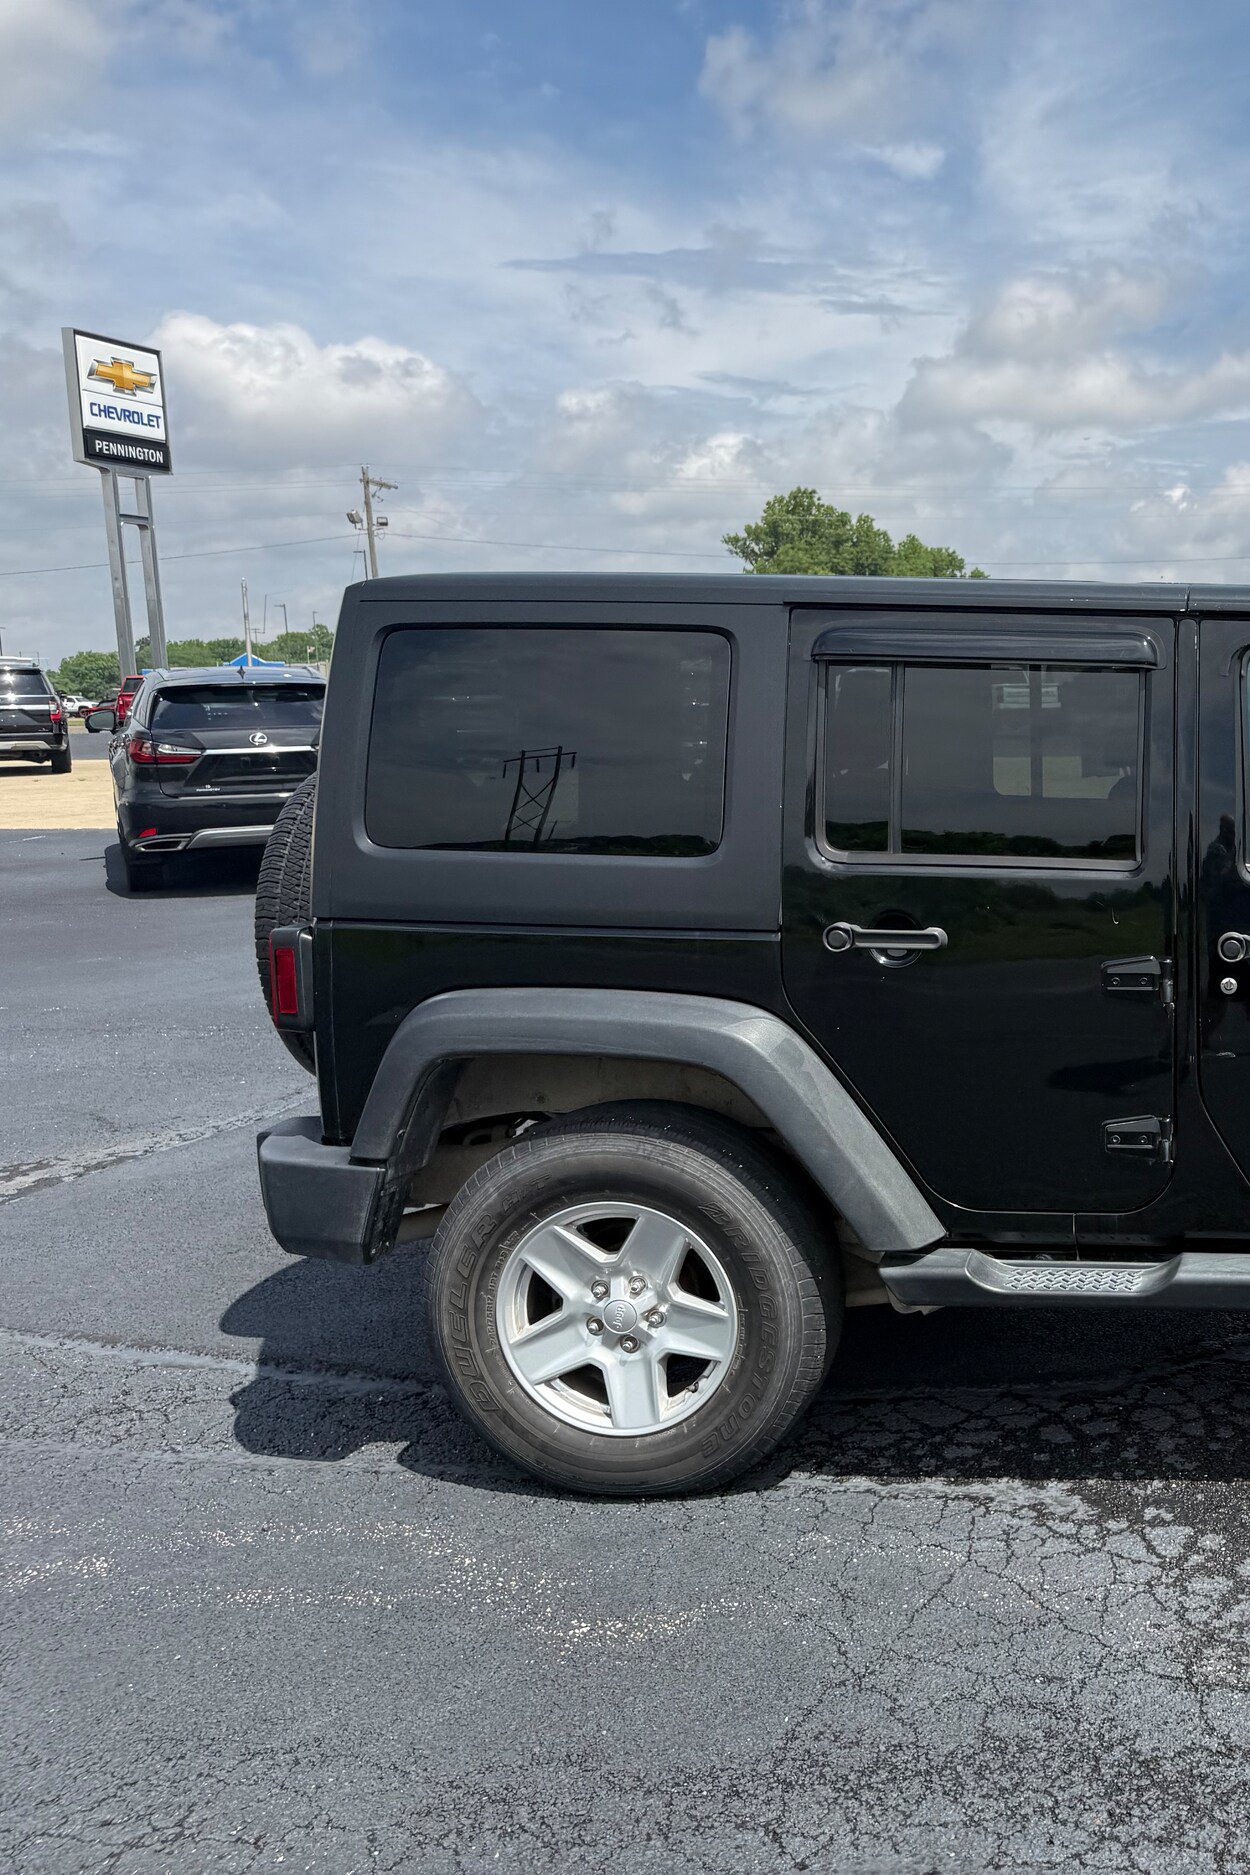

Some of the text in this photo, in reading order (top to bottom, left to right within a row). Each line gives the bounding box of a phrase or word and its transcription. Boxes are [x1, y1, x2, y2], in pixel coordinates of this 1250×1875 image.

[89, 402, 162, 429] CHEVROLET
[95, 439, 164, 464] PENNINGTON
[612, 1304, 626, 1329] Jeep
[698, 1200, 779, 1458] BRIDGESTONE
